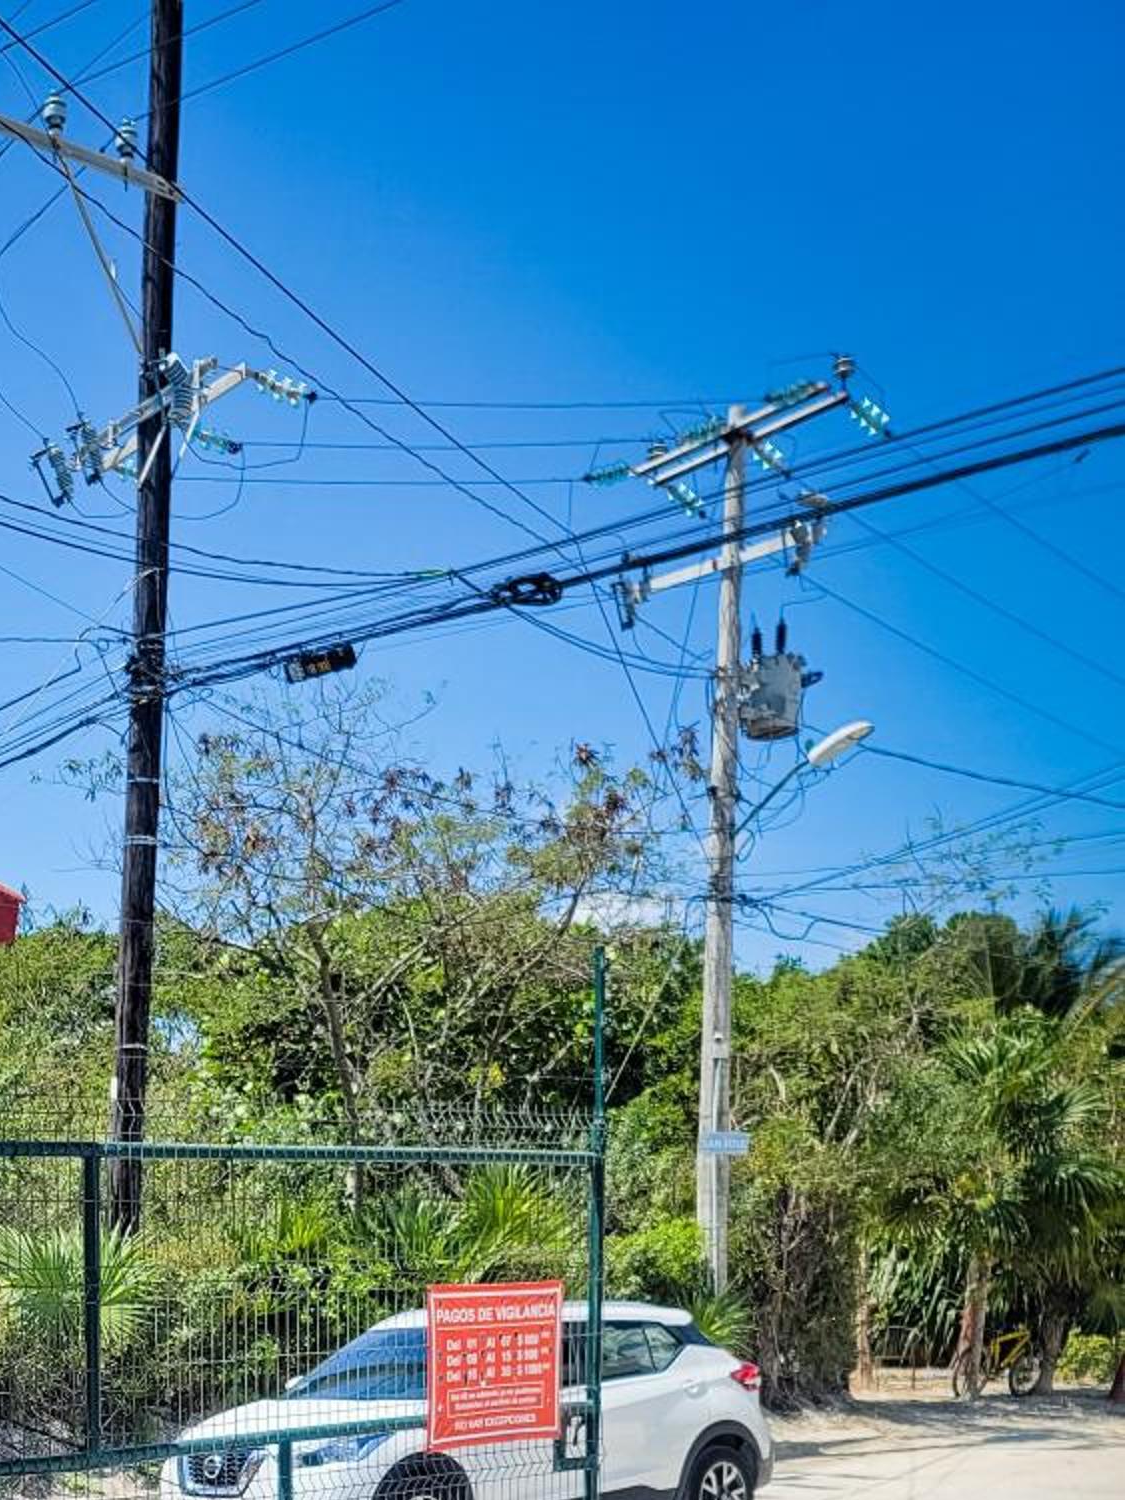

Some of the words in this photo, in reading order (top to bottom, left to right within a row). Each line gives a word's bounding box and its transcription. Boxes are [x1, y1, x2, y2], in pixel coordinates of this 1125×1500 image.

[436, 1308, 475, 1323] PAGOS
[478, 1307, 494, 1321] DE
[495, 1303, 555, 1321] VIGILANCIA
